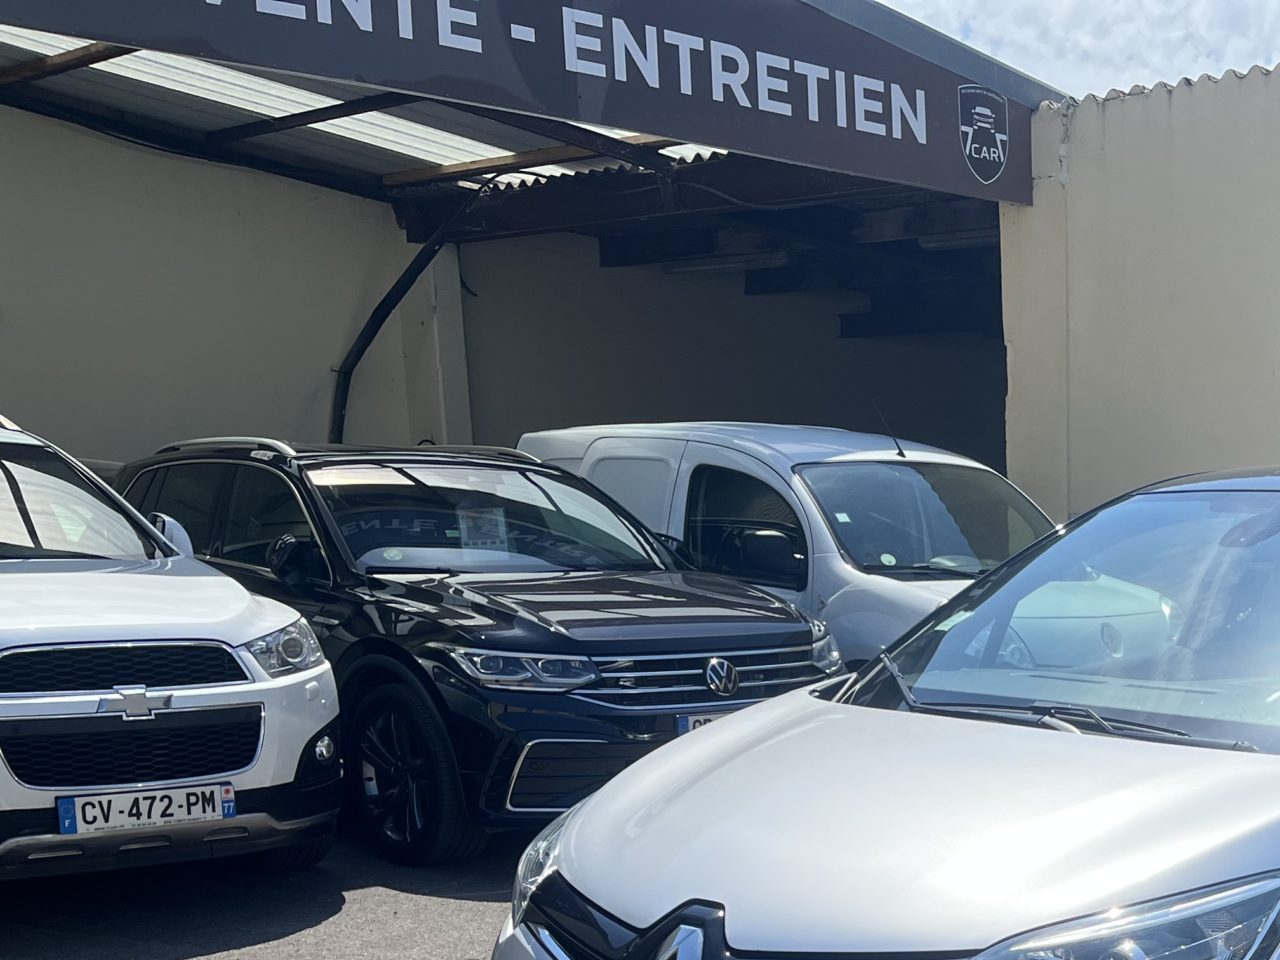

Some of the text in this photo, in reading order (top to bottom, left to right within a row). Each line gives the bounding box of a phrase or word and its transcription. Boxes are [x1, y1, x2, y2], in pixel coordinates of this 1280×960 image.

[562, 6, 927, 145] ENTRETIEN
[80, 790, 216, 826] CV-472-PM
[223, 803, 234, 814] 77
[64, 820, 71, 828] F
